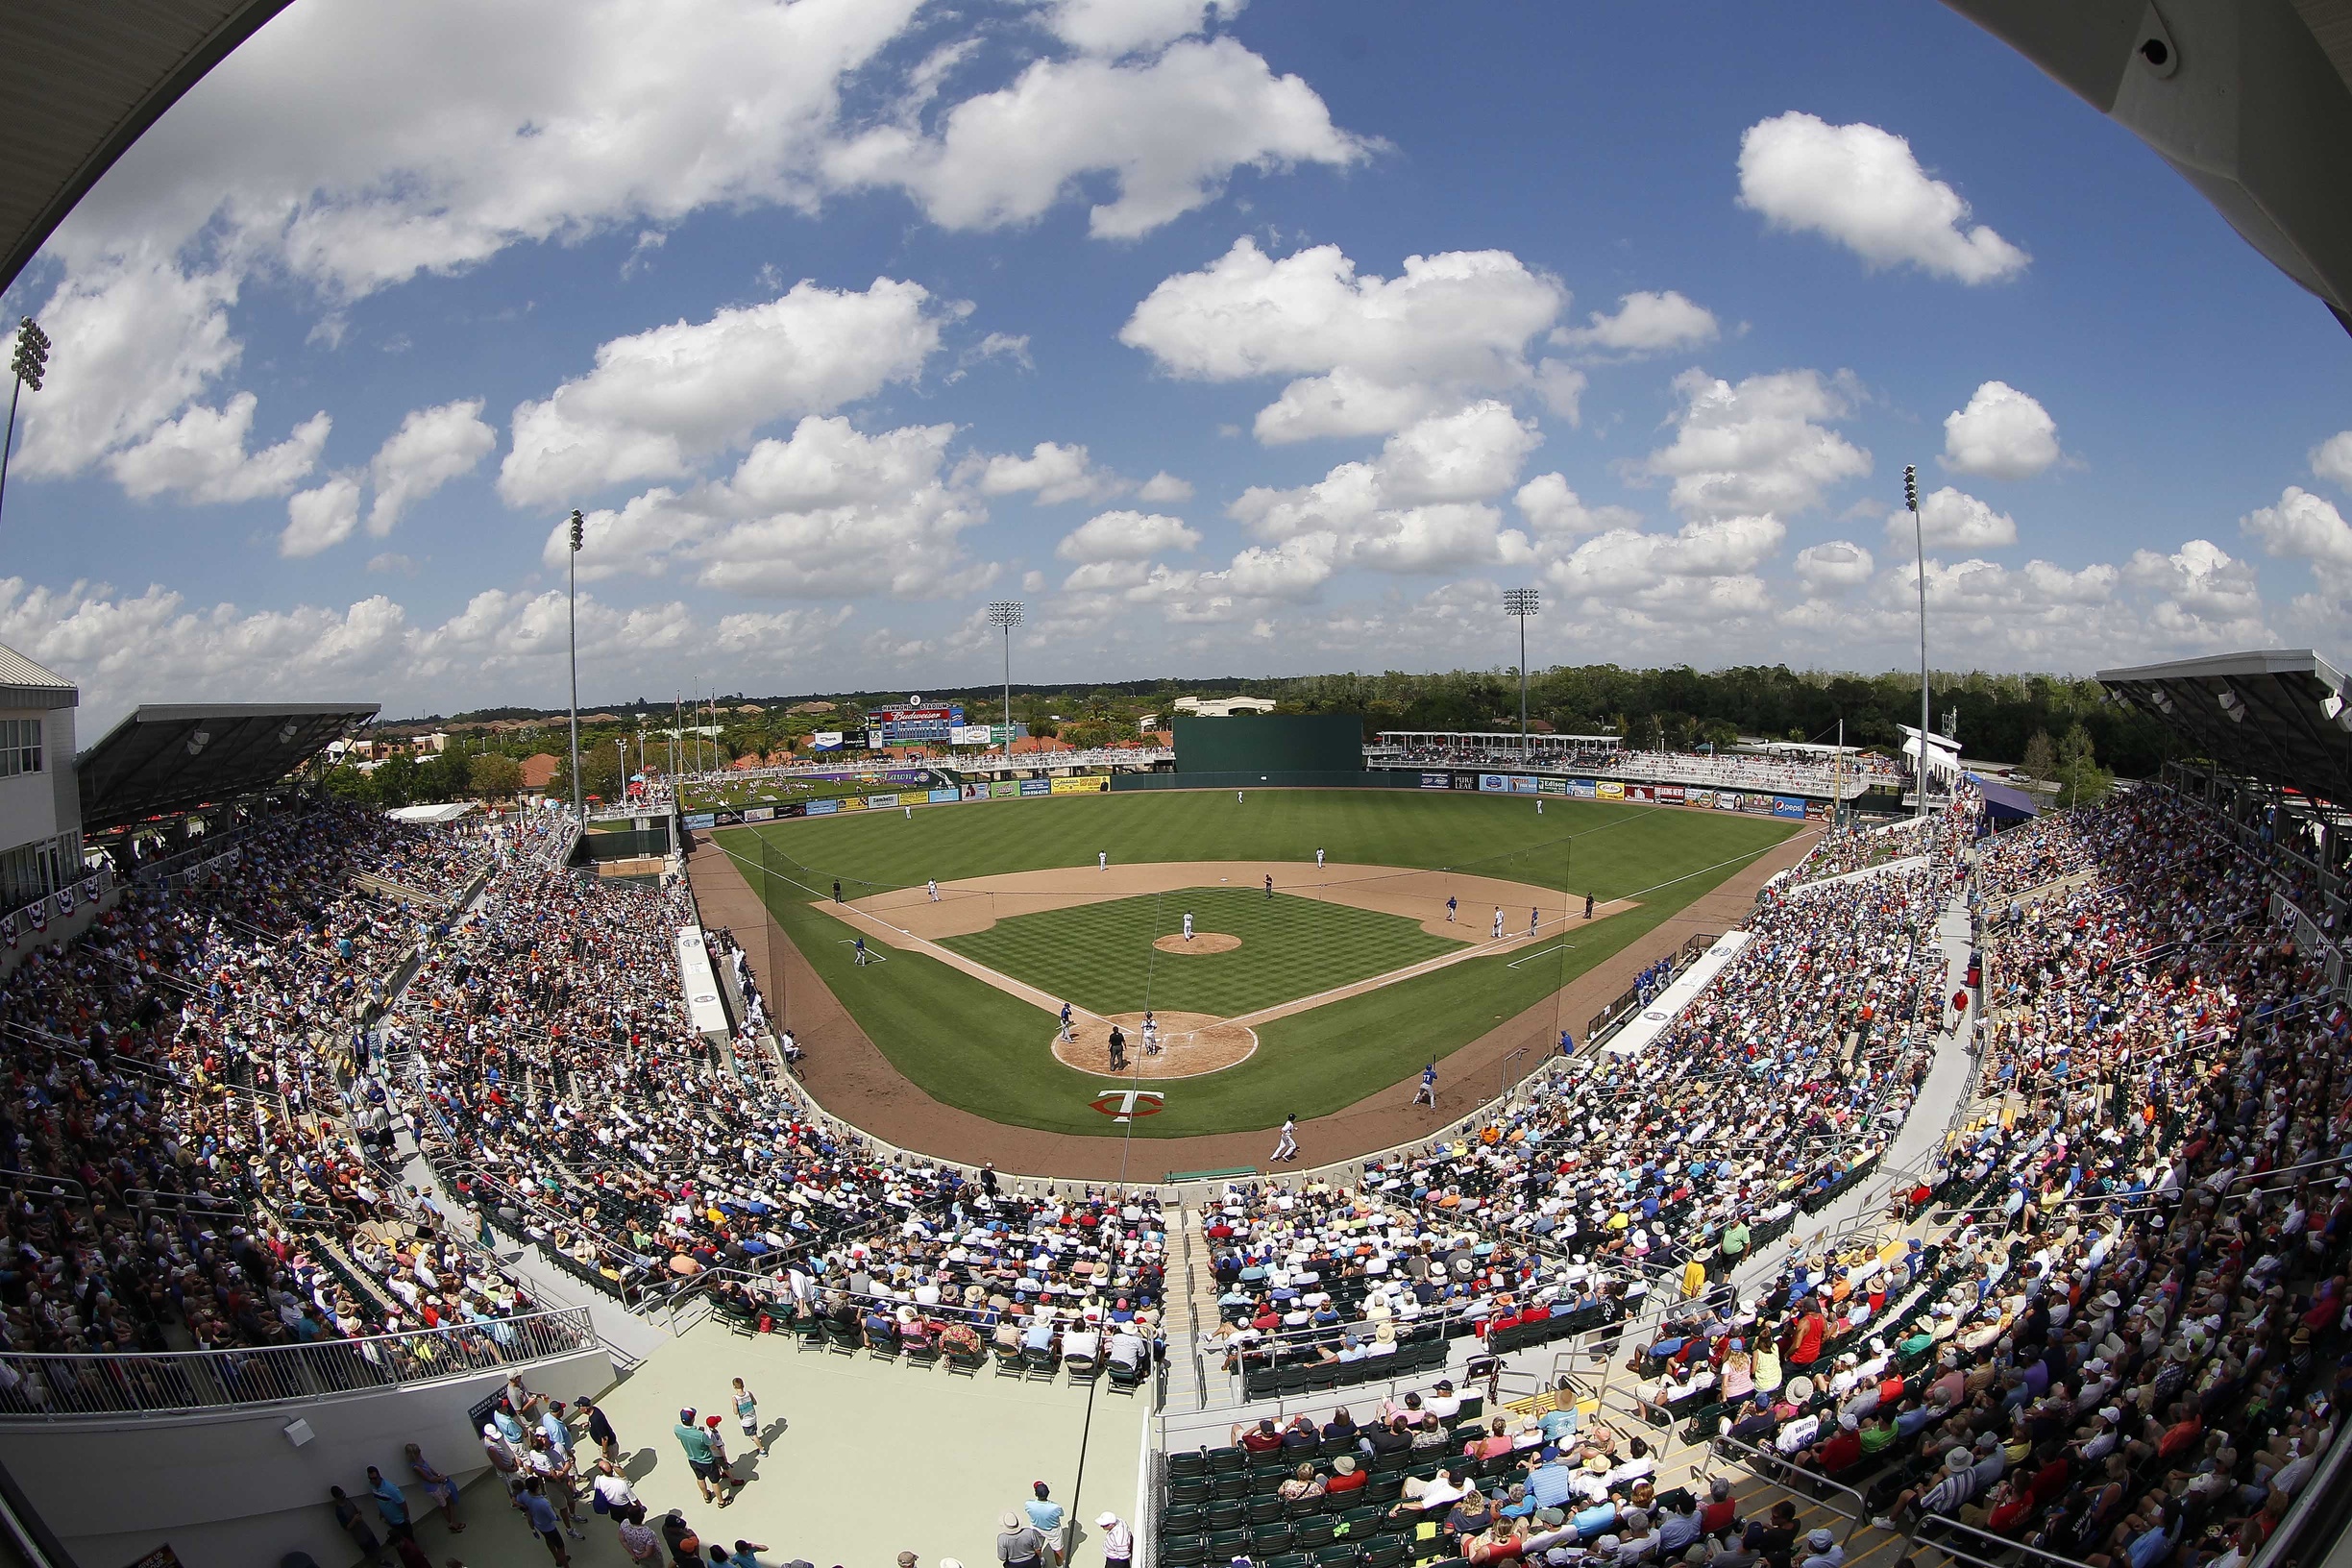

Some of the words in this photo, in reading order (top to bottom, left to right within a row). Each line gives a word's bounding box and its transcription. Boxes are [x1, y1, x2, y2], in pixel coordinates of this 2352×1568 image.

[891, 711, 941, 722] Budweiser
[884, 772, 912, 781] Lawn
[1654, 786, 1672, 796] BREAKING
[1673, 788, 1684, 796] NEWS
[1784, 803, 1802, 813] pepsi
[471, 1399, 492, 1415] BEWARE
[1795, 1420, 1817, 1434] BAUTISTA
